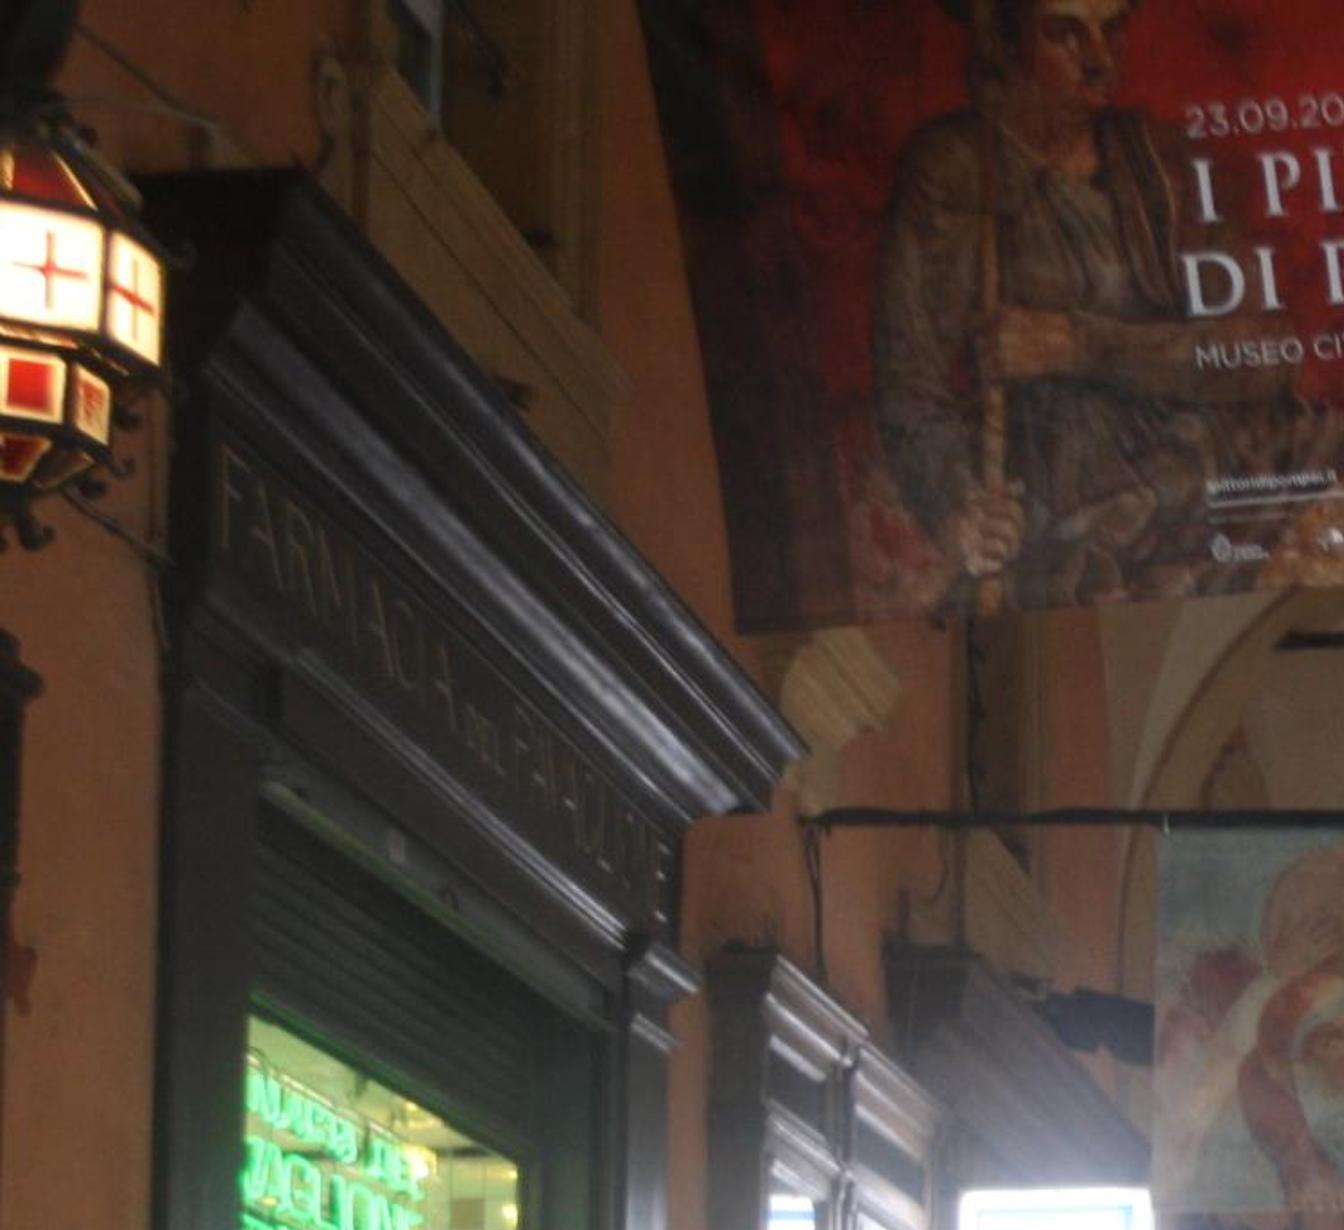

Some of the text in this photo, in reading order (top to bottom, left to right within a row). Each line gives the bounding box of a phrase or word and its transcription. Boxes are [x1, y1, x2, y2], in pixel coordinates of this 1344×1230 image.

[1190, 157, 1222, 224] I
[1180, 246, 1285, 318] DI
[1195, 337, 1304, 371] MUSEO
